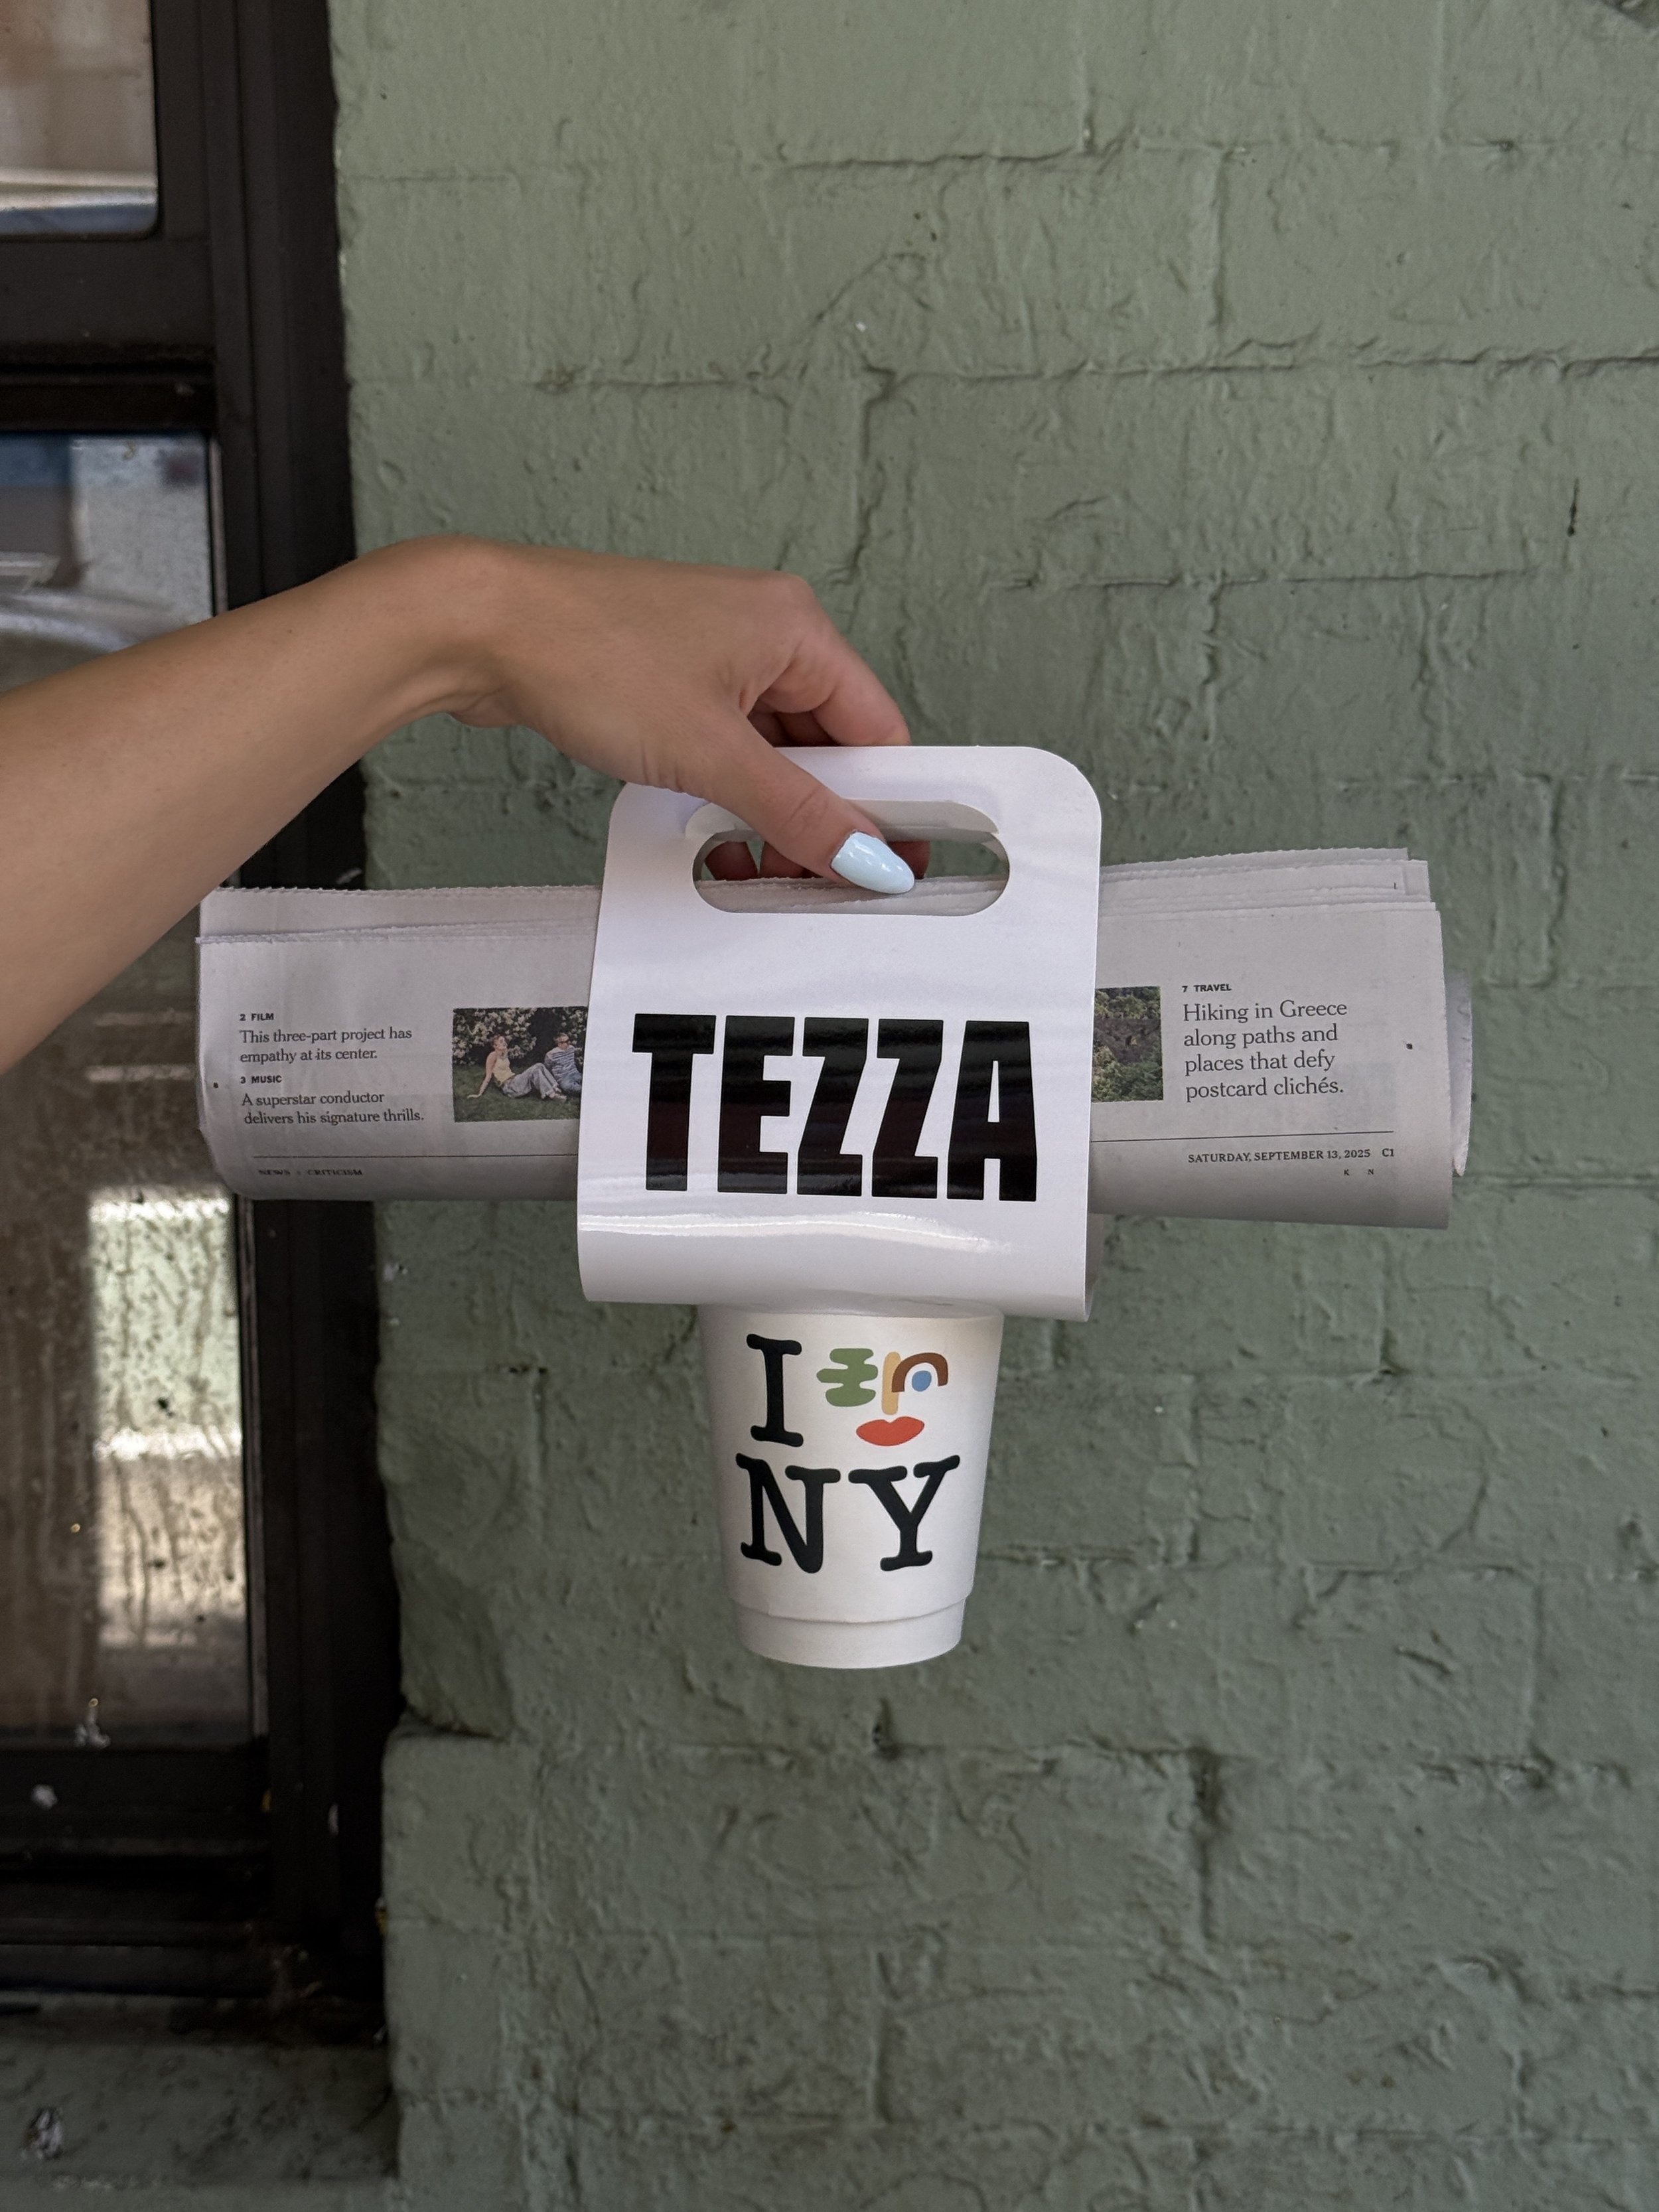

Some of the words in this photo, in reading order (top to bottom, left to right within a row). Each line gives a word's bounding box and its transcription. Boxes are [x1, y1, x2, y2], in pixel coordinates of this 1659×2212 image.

[1193, 984, 1232, 992] TRAVEL
[251, 1012, 275, 1021] FILM
[1183, 1003, 1250, 1024] Hiking
[1254, 1003, 1273, 1019] in
[1279, 999, 1347, 1018] Greece
[239, 1029, 270, 1043] This
[273, 1029, 337, 1045] three-part
[340, 1027, 386, 1043] project
[389, 1027, 412, 1039] has
[1183, 1029, 1237, 1049] along
[1242, 1025, 1295, 1048] paths
[1301, 1023, 1338, 1043] and
[240, 1048, 297, 1065] empathy
[299, 1050, 313, 1061] at
[315, 1048, 332, 1061] its
[334, 1048, 378, 1060] center.
[1185, 1055, 1244, 1077] places
[1250, 1052, 1288, 1070] that
[1293, 1050, 1336, 1072] defy
[240, 1076, 246, 1084] 3
[251, 1074, 282, 1084] MUSIC
[1185, 1078, 1267, 1103] postcard
[1273, 1075, 1344, 1096] clichés.
[241, 1092, 253, 1106] A
[255, 1094, 317, 1108] superstar
[319, 1090, 385, 1104] conductor
[632, 1013, 1037, 1202] TEZZA
[244, 1110, 294, 1125] delivers
[296, 1110, 317, 1124] his
[319, 1110, 380, 1126] signature
[383, 1108, 424, 1122] thrills.
[1188, 1152, 1252, 1163] SATURDAY,
[1254, 1150, 1325, 1161] SEPTEMBER
[1327, 1150, 1342, 1160] 13,
[1344, 1148, 1371, 1159] 2025
[1382, 1147, 1394, 1157] C1
[746, 1334, 804, 1447] I
[735, 1452, 960, 1574] NY
